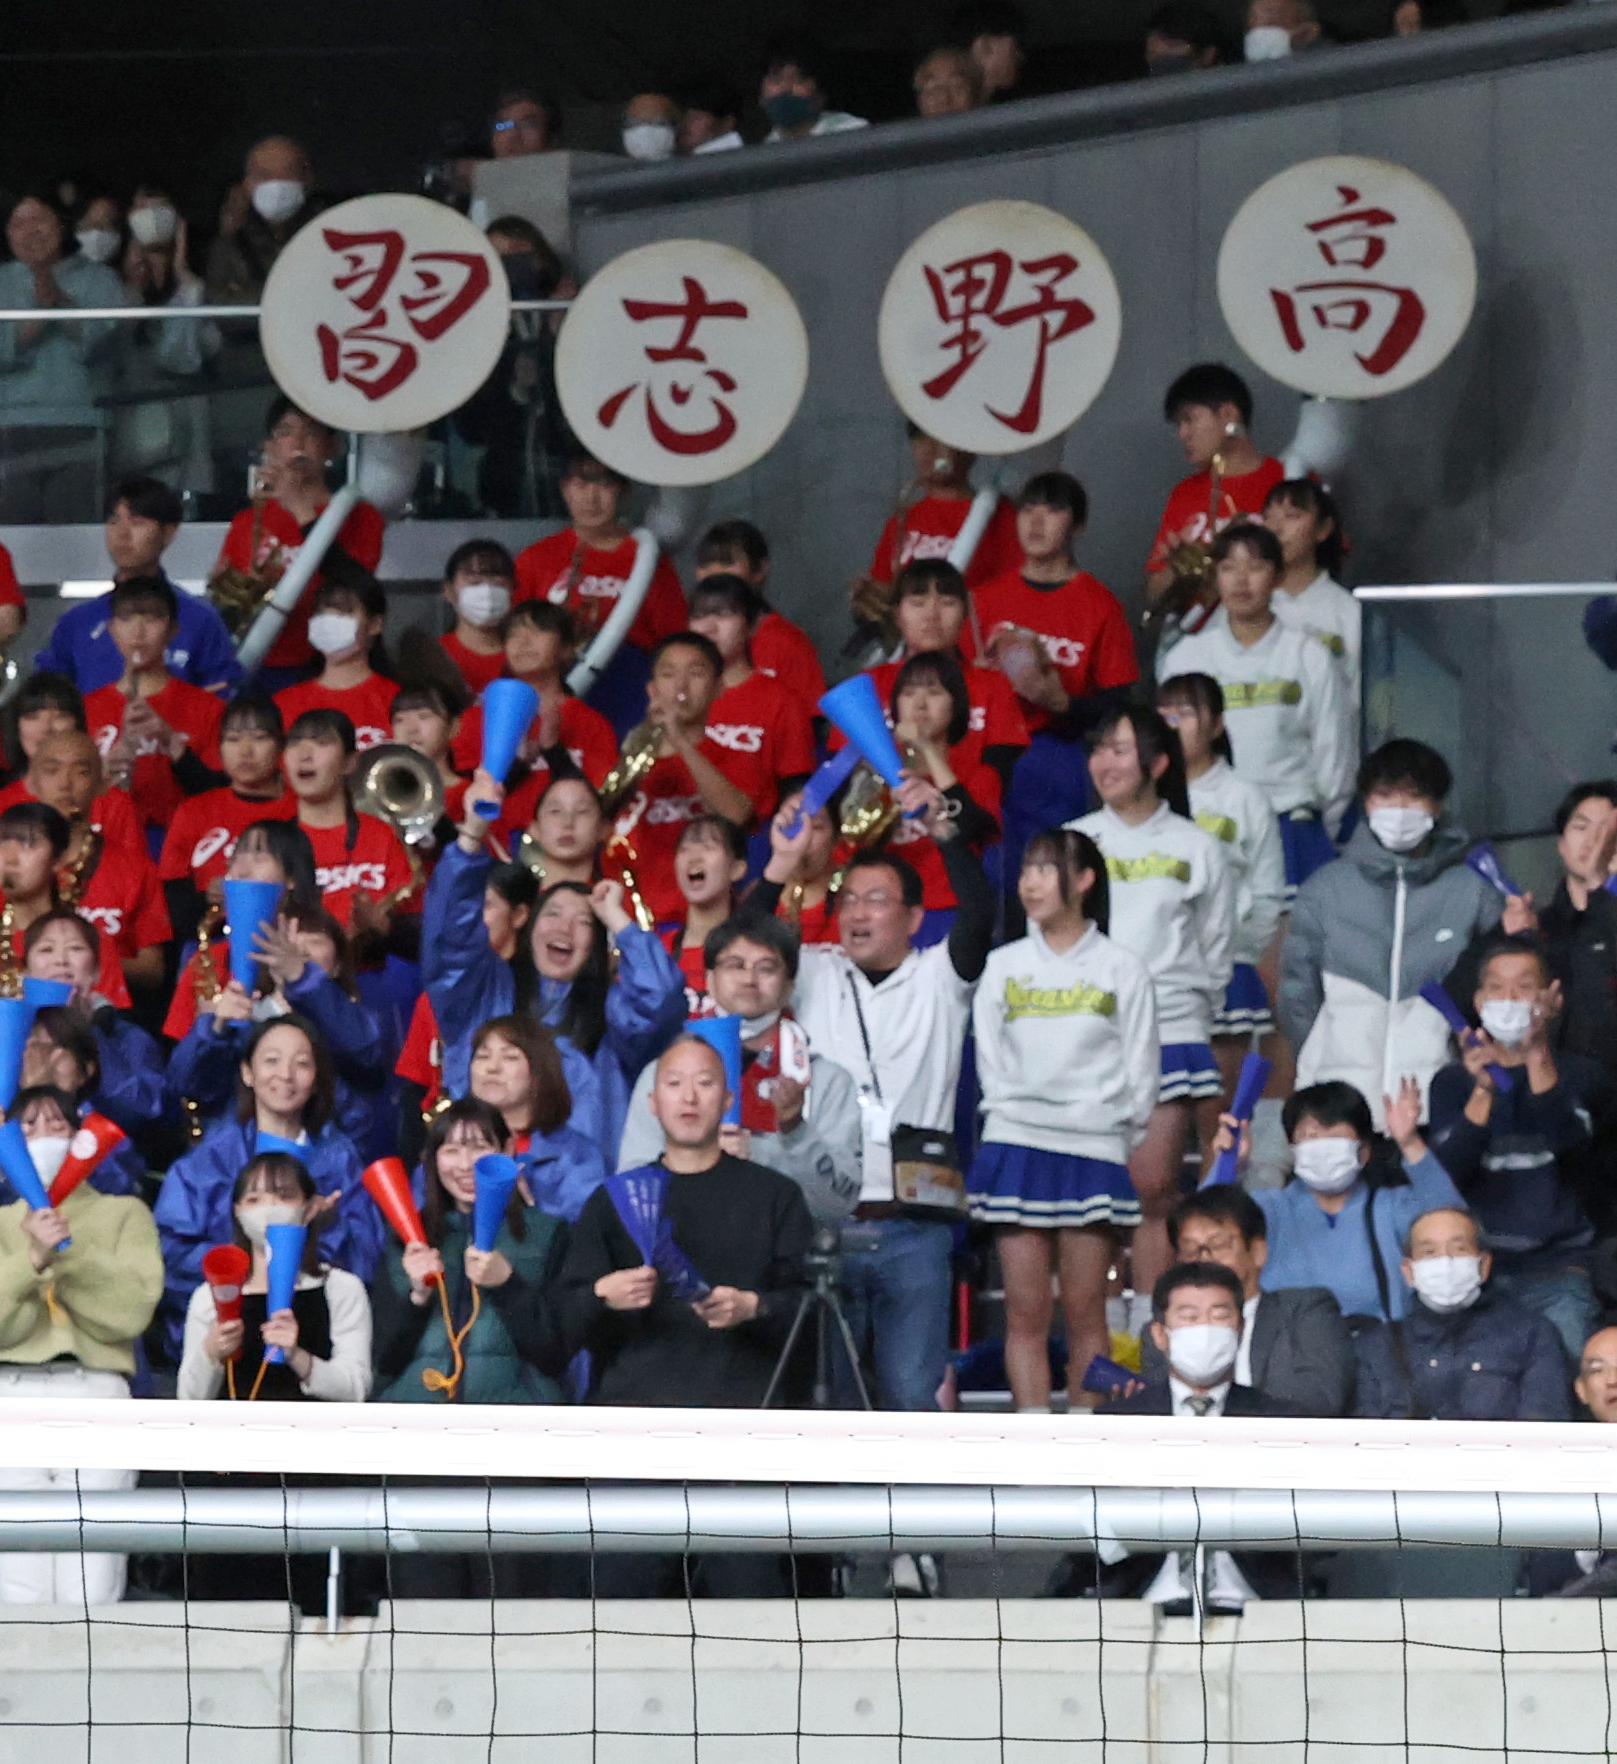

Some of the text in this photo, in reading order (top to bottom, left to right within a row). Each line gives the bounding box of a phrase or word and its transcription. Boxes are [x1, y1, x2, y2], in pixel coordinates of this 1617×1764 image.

[316, 185, 1426, 455] 習 志 野 高
